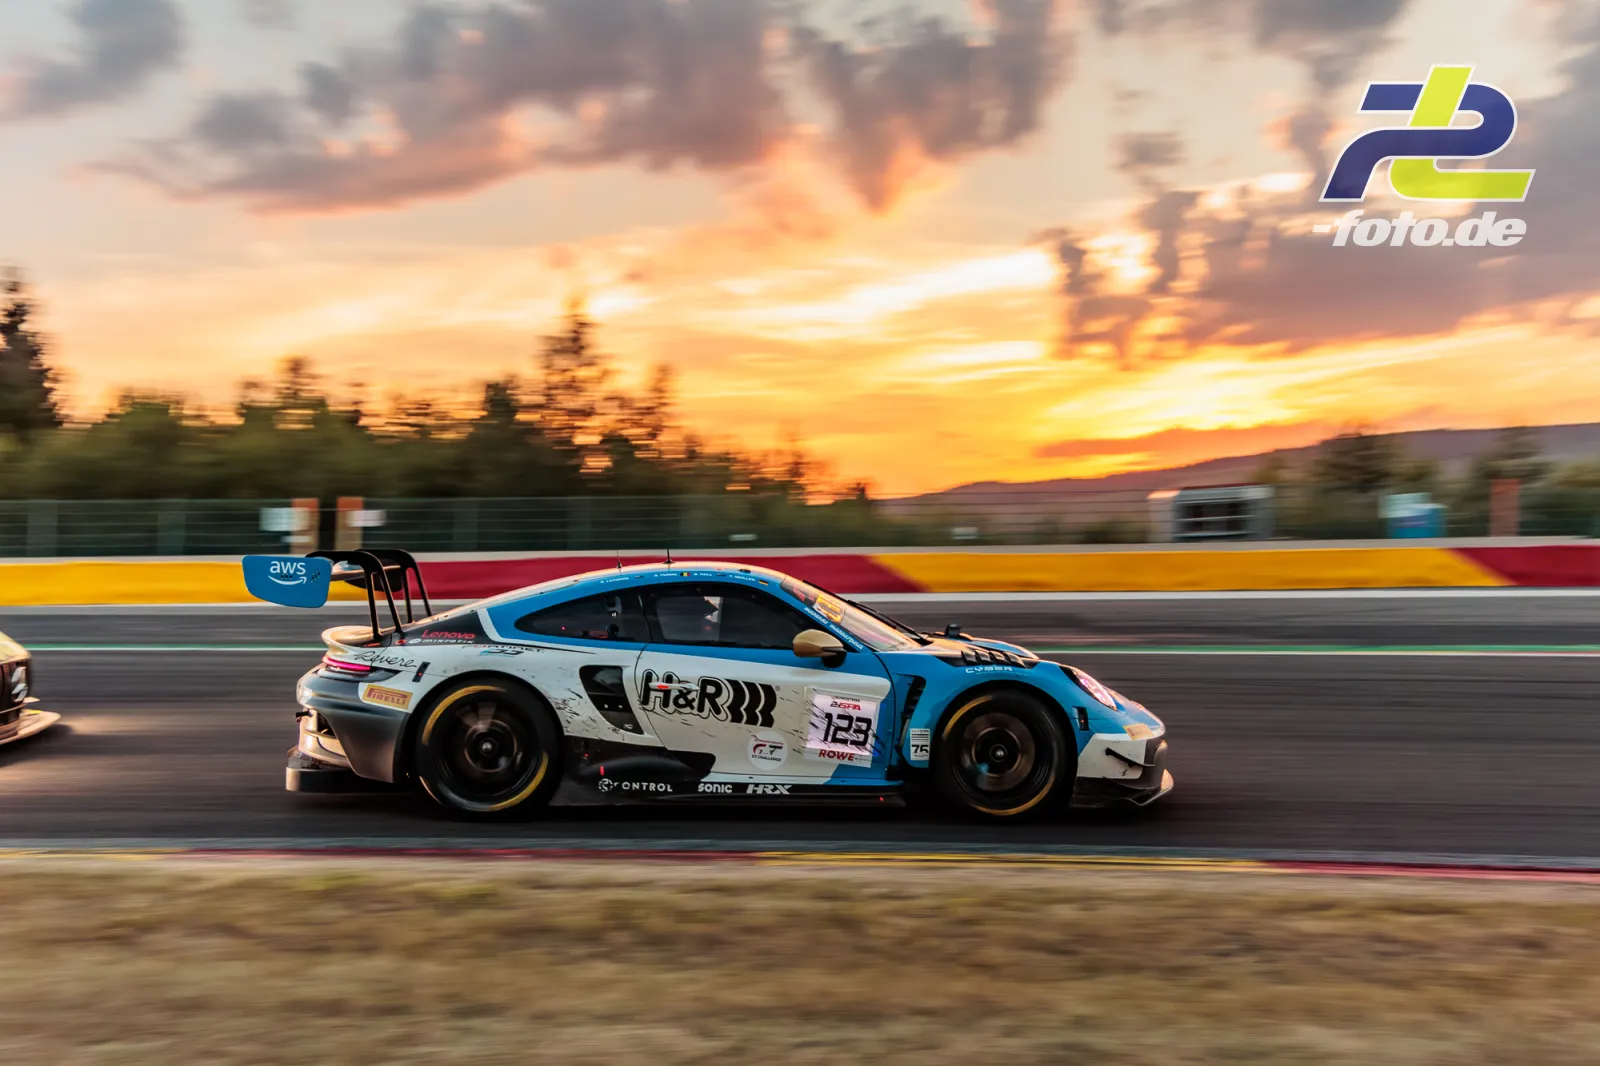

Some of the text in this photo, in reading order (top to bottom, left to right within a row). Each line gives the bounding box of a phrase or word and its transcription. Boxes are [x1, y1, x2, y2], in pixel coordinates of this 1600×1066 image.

[270, 561, 306, 575] aws
[421, 629, 476, 640] Lenovo
[965, 665, 1013, 674] CYBER
[366, 687, 408, 706] PIRELLI
[640, 669, 729, 722] H&R
[823, 712, 872, 747] 123
[819, 749, 855, 761] ROWE
[911, 745, 929, 754] 75
[746, 784, 793, 795] HRX
